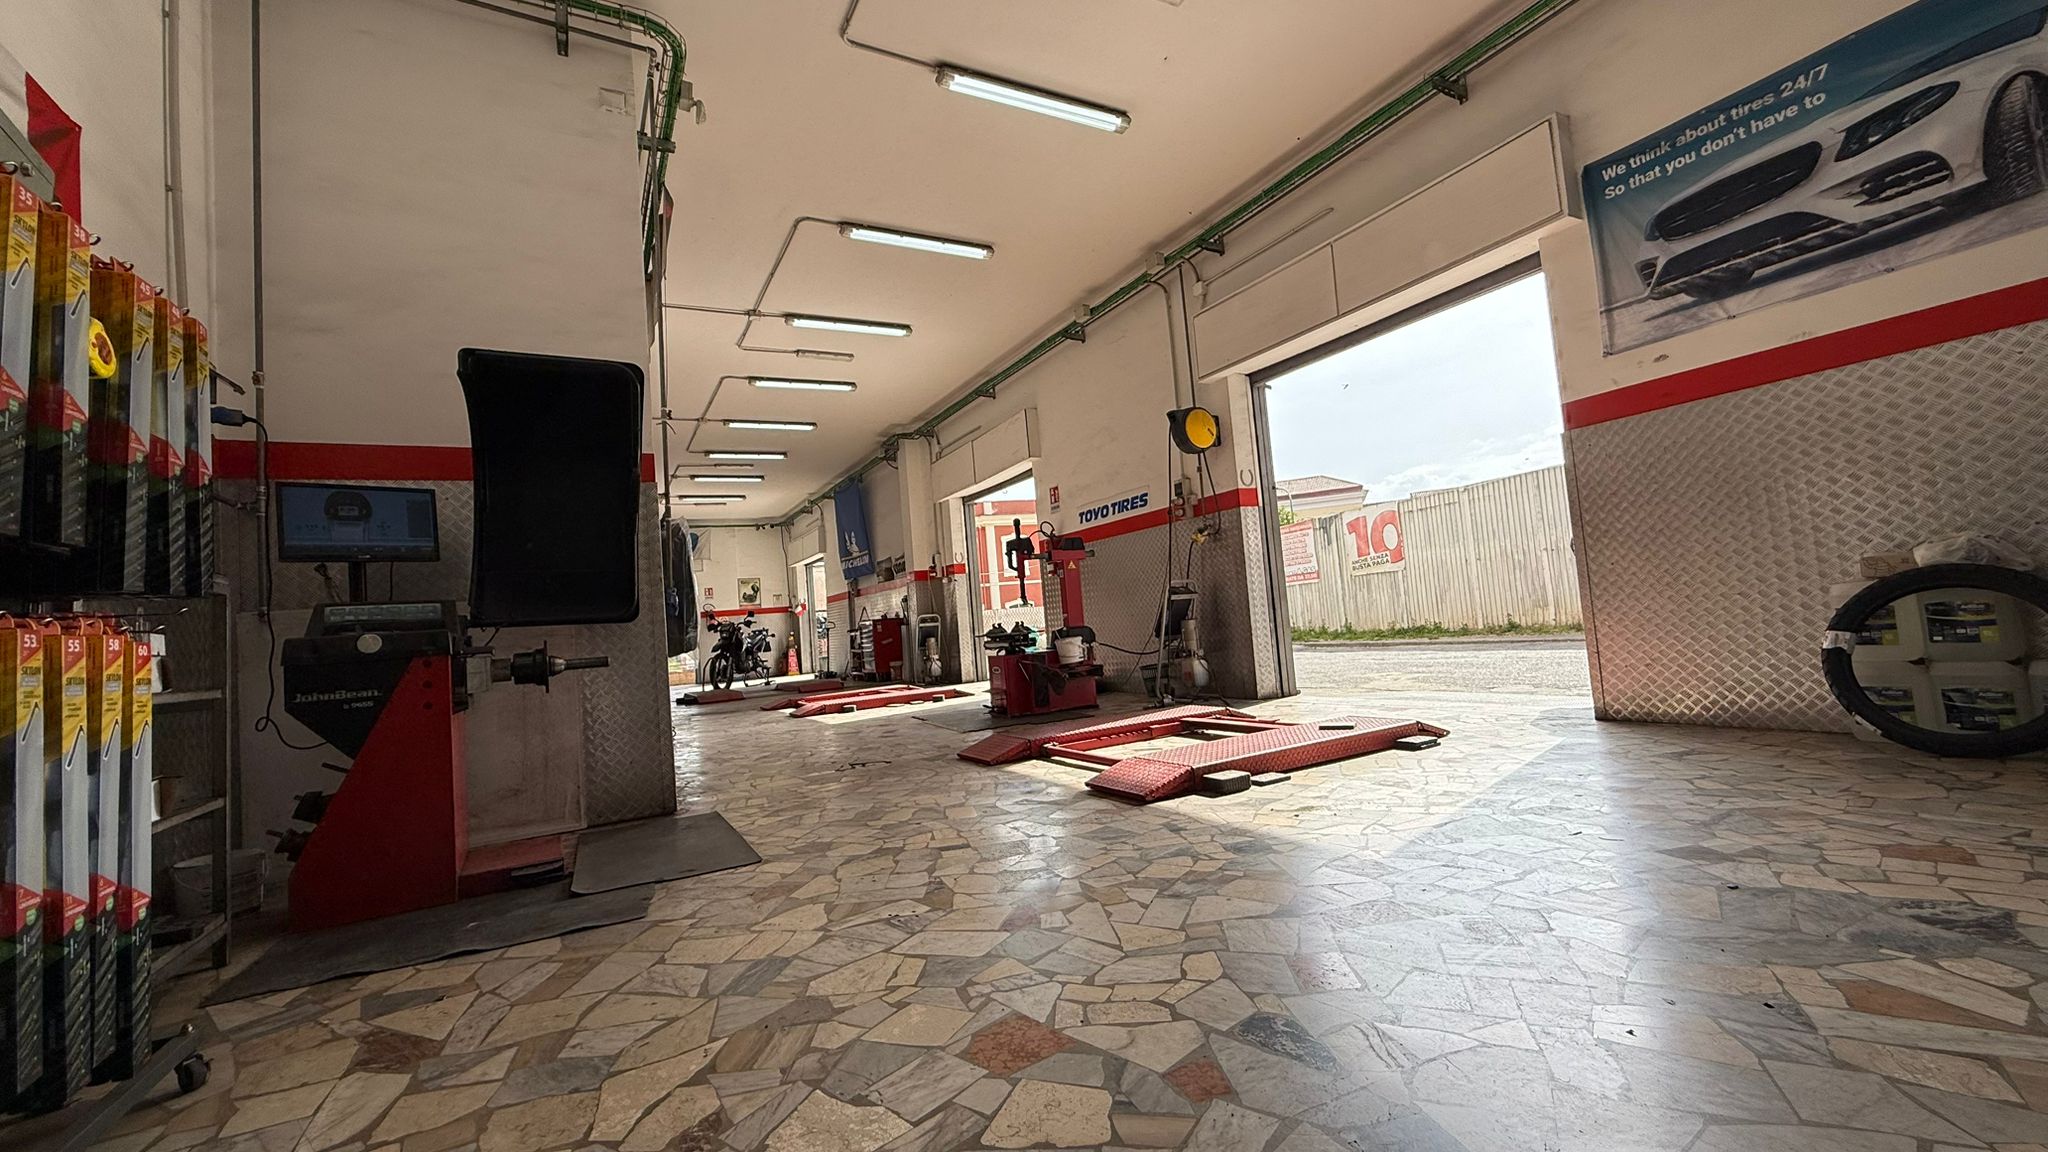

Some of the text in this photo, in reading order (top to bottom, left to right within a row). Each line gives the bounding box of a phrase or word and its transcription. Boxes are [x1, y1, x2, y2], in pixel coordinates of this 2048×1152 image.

[1601, 63, 1829, 182] We think about tires 24/7
[1604, 91, 1827, 200] So that you don't have to
[18, 186, 33, 206] 35
[73, 223, 86, 242] 38
[139, 281, 151, 296] 45
[1078, 492, 1149, 524] TOYO TIRES
[1346, 509, 1404, 564] 10
[1351, 552, 1389, 565] ANCHE SENZA
[1352, 557, 1390, 571] BUSTA PAGA
[23, 634, 37, 647] 53
[67, 639, 80, 652] 55
[108, 638, 119, 651] 58
[138, 645, 148, 656] 60
